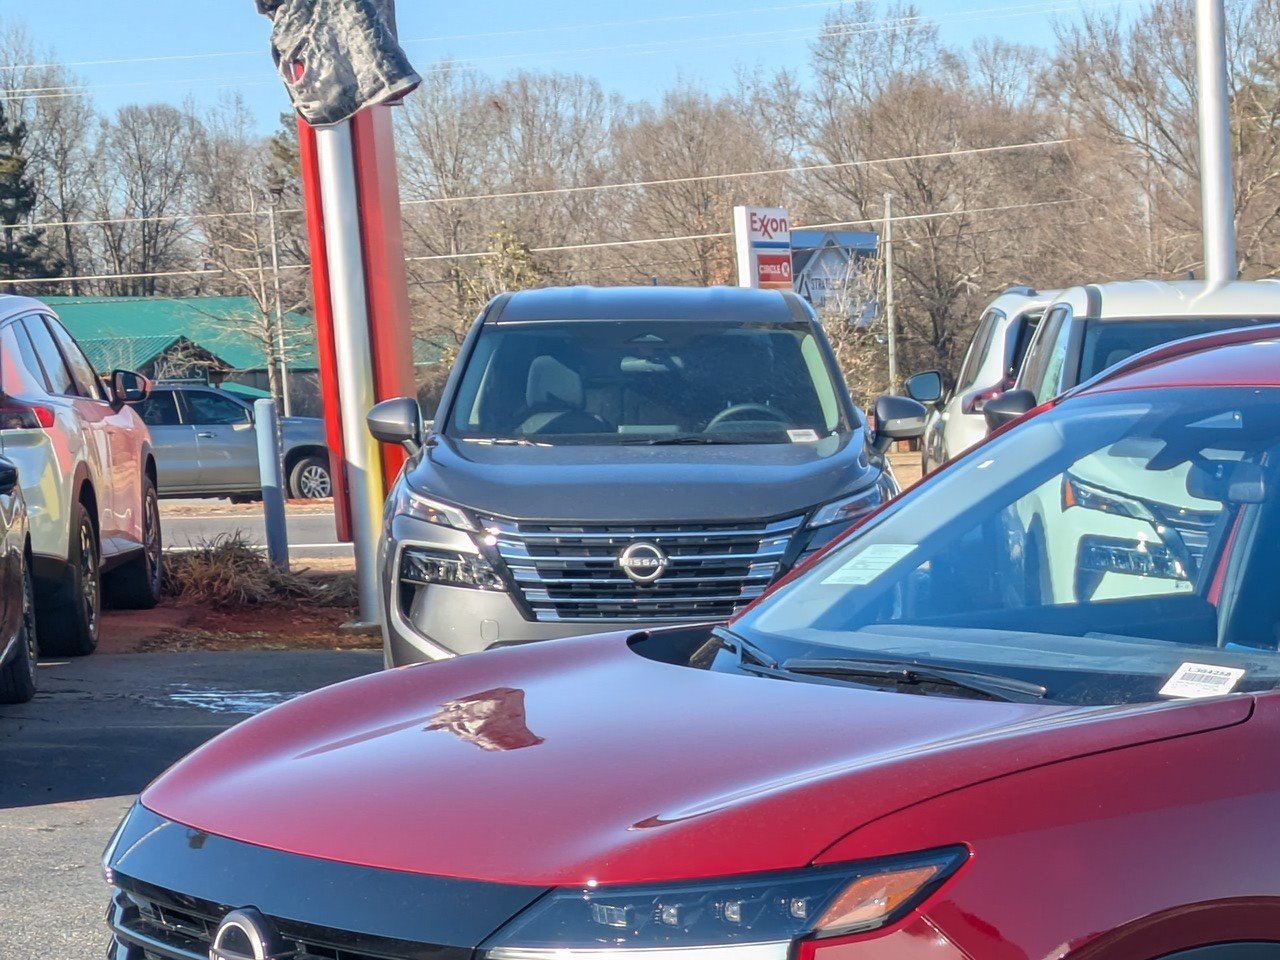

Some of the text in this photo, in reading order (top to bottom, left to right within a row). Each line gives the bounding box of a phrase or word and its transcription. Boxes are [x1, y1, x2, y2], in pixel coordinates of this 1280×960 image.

[750, 212, 788, 239] Exxon
[759, 264, 781, 274] CIRCLE
[619, 558, 667, 567] NISSAN
